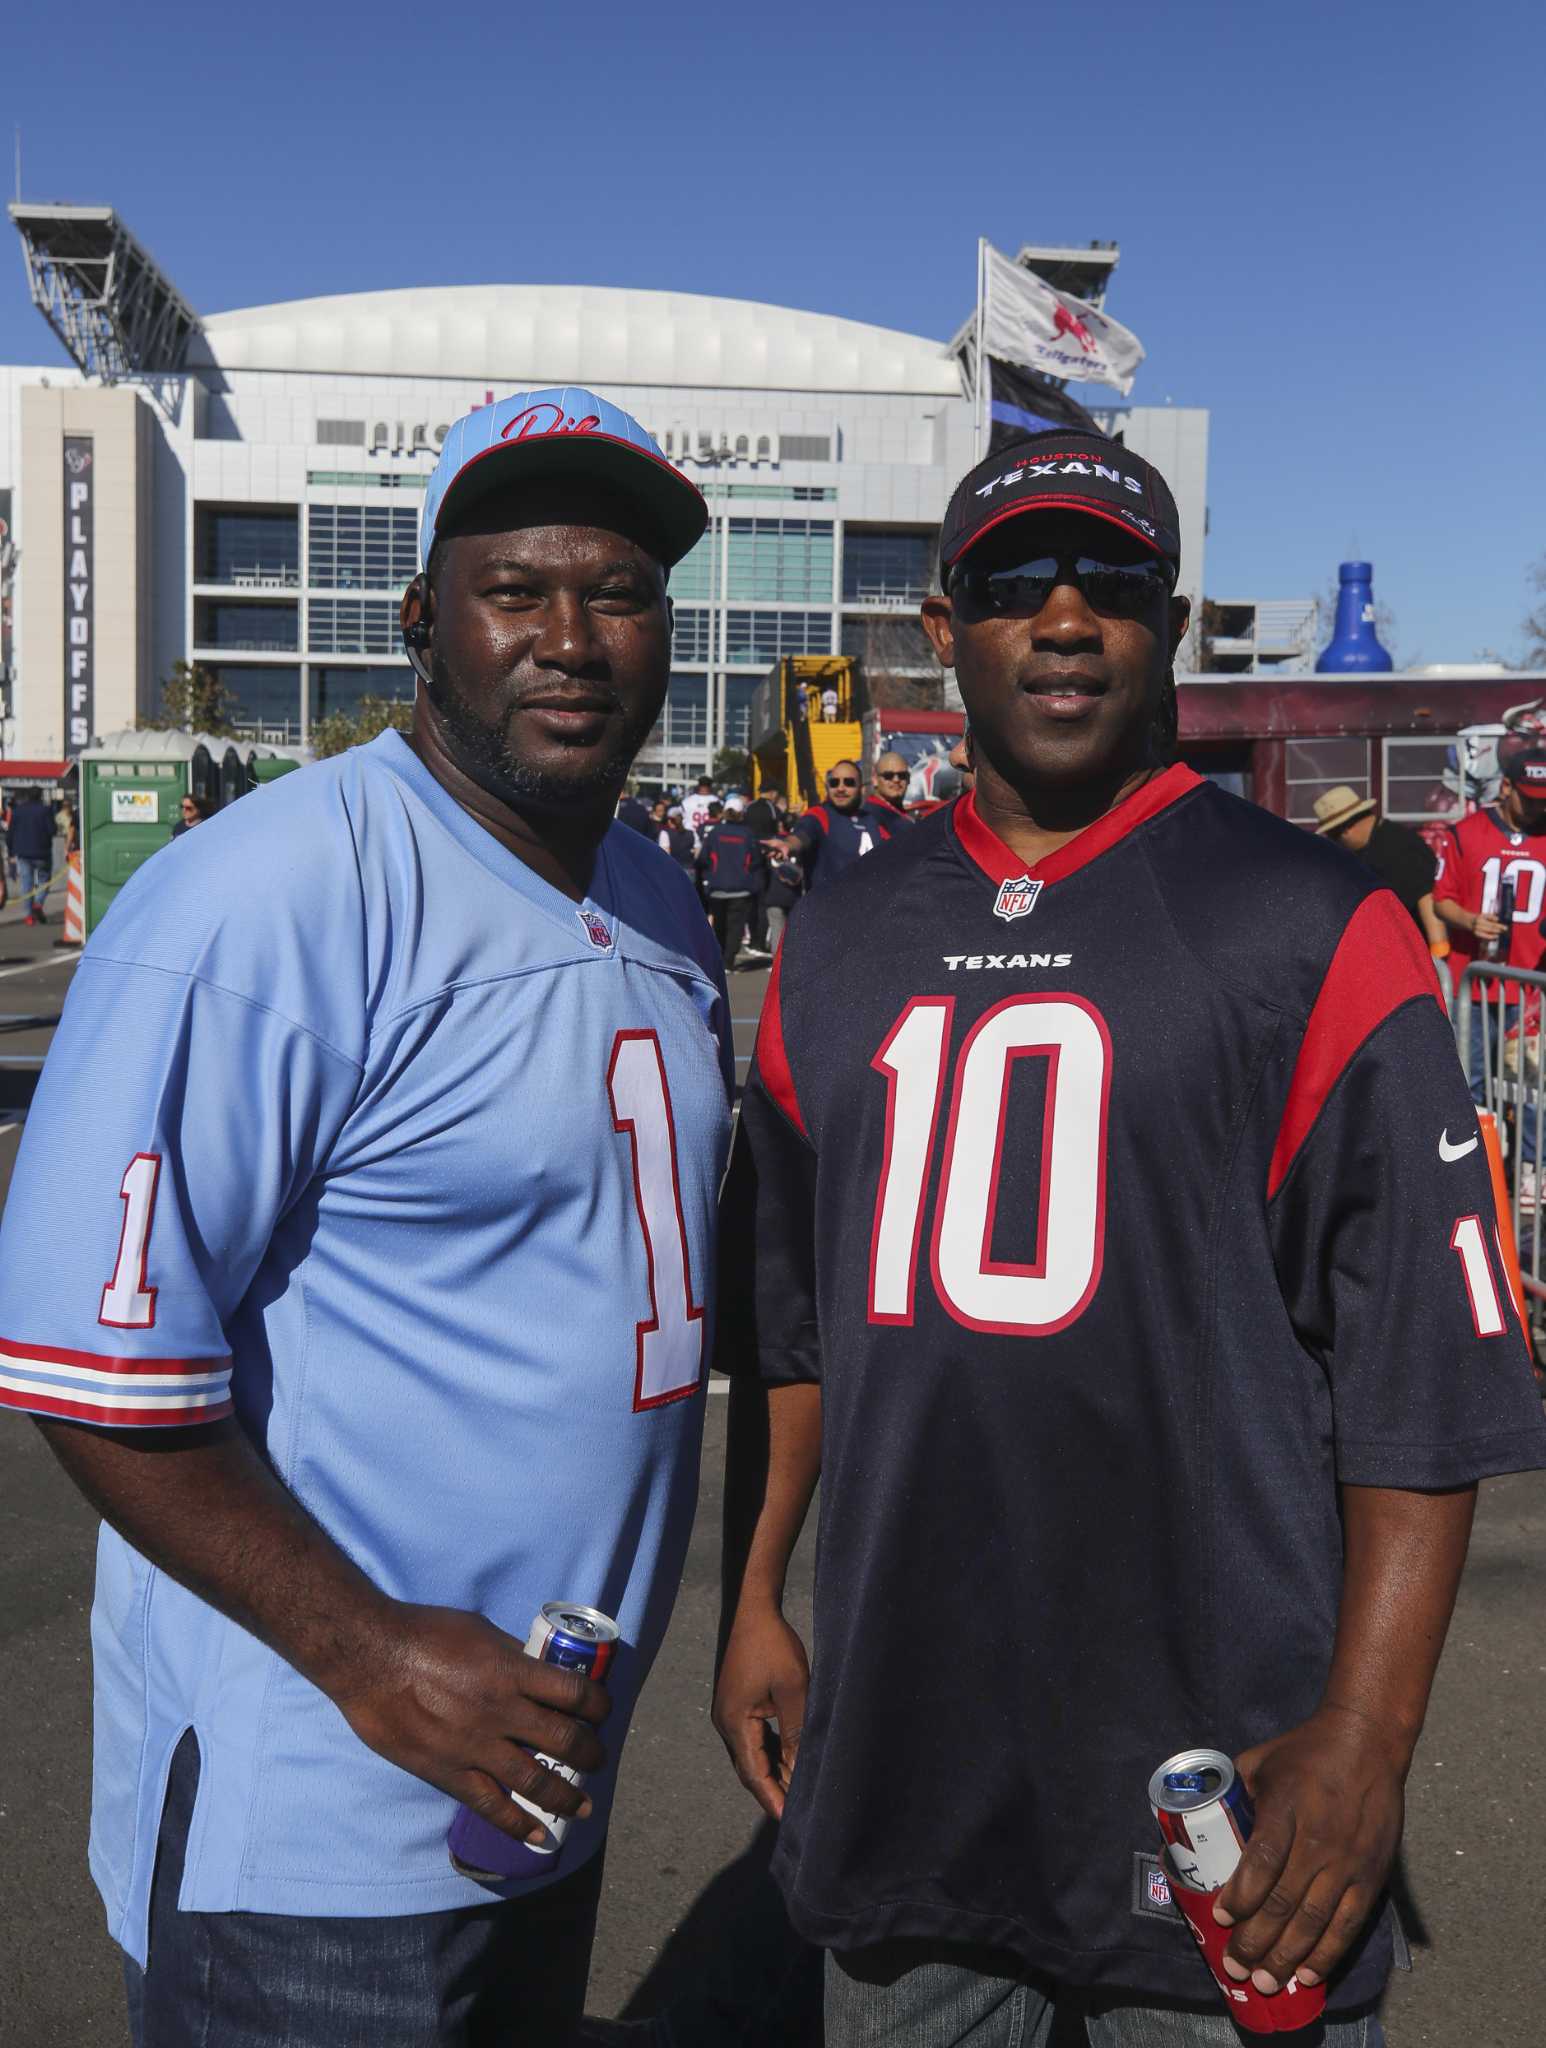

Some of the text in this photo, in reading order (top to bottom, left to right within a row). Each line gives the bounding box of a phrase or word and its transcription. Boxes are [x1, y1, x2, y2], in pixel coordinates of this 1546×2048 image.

[975, 461, 1144, 499] TEXANS
[1014, 452, 1104, 469] HOUSTON
[70, 481, 89, 746] PLAYOFFS
[1000, 893, 1028, 913] NFL
[1481, 857, 1546, 923] 10
[942, 953, 1073, 971] TEXANS
[866, 990, 1114, 1337] 10
[97, 1151, 162, 1329] 1
[606, 1028, 704, 1413] 1
[1450, 1214, 1520, 1339] 1
[1151, 1883, 1169, 1902] NFL
